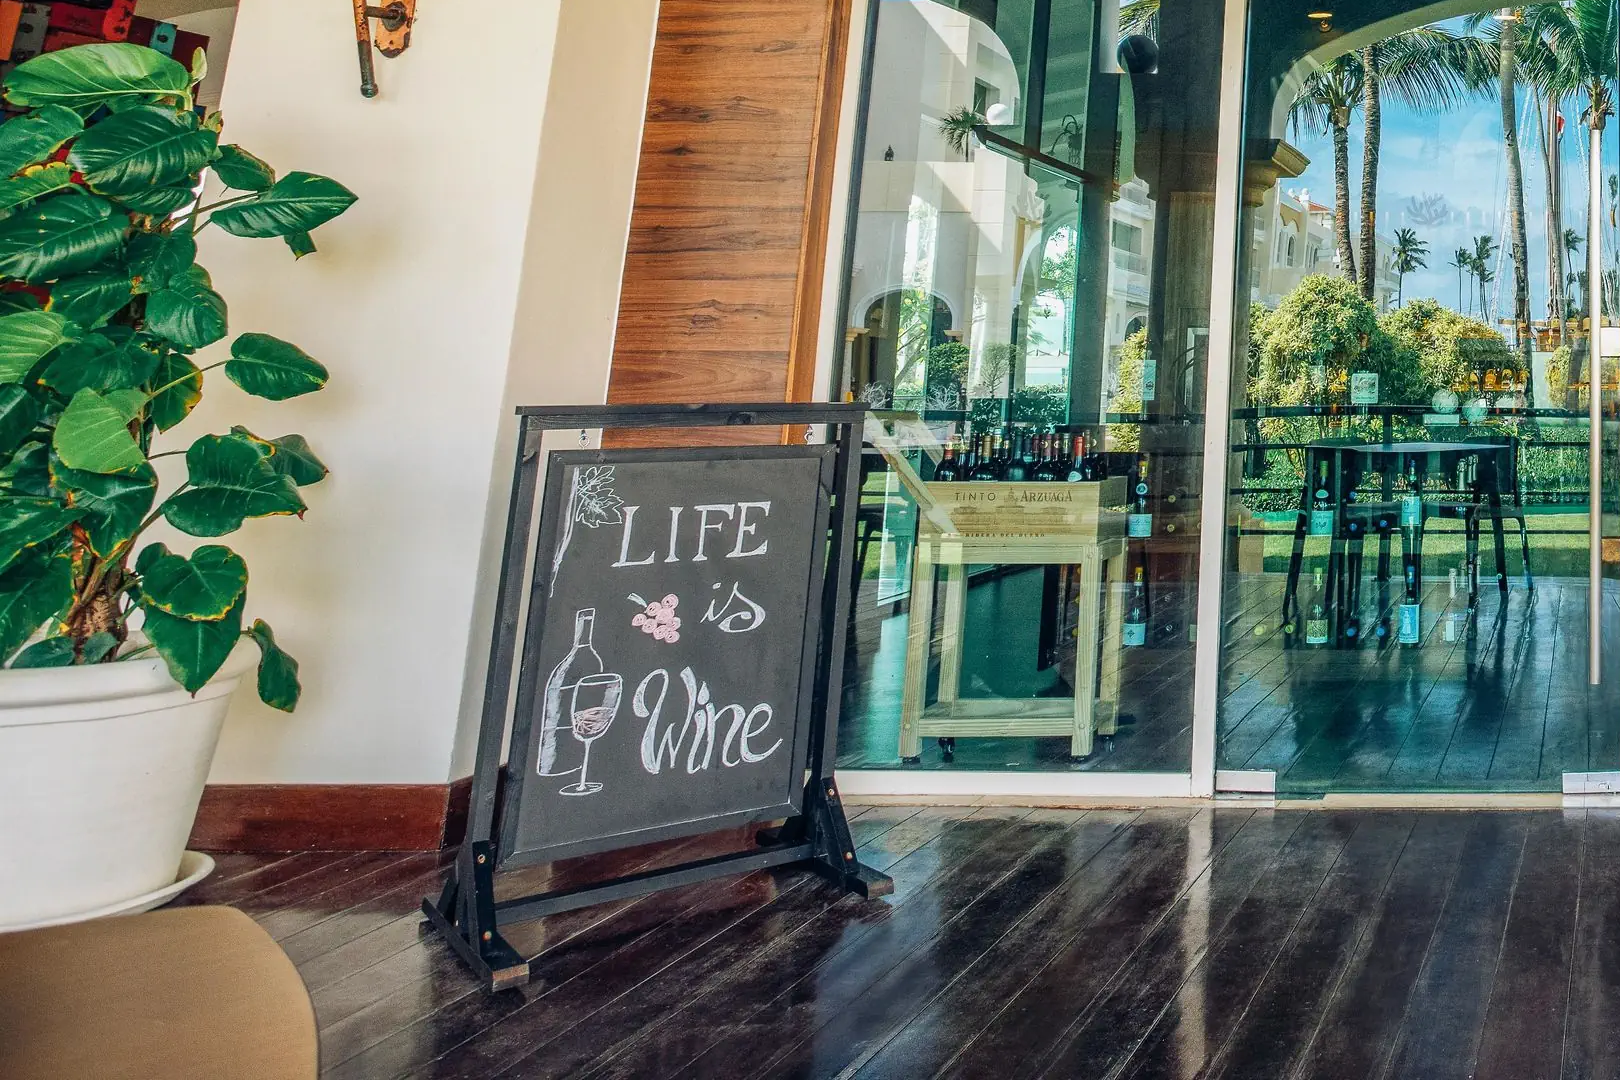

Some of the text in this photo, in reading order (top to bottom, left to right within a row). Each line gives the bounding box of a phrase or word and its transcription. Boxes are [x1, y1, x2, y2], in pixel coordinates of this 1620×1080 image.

[954, 490, 1073, 502] TINTO ARZUAGA
[610, 500, 772, 568] LIFE
[700, 580, 766, 633] is
[632, 666, 784, 775] Wine
